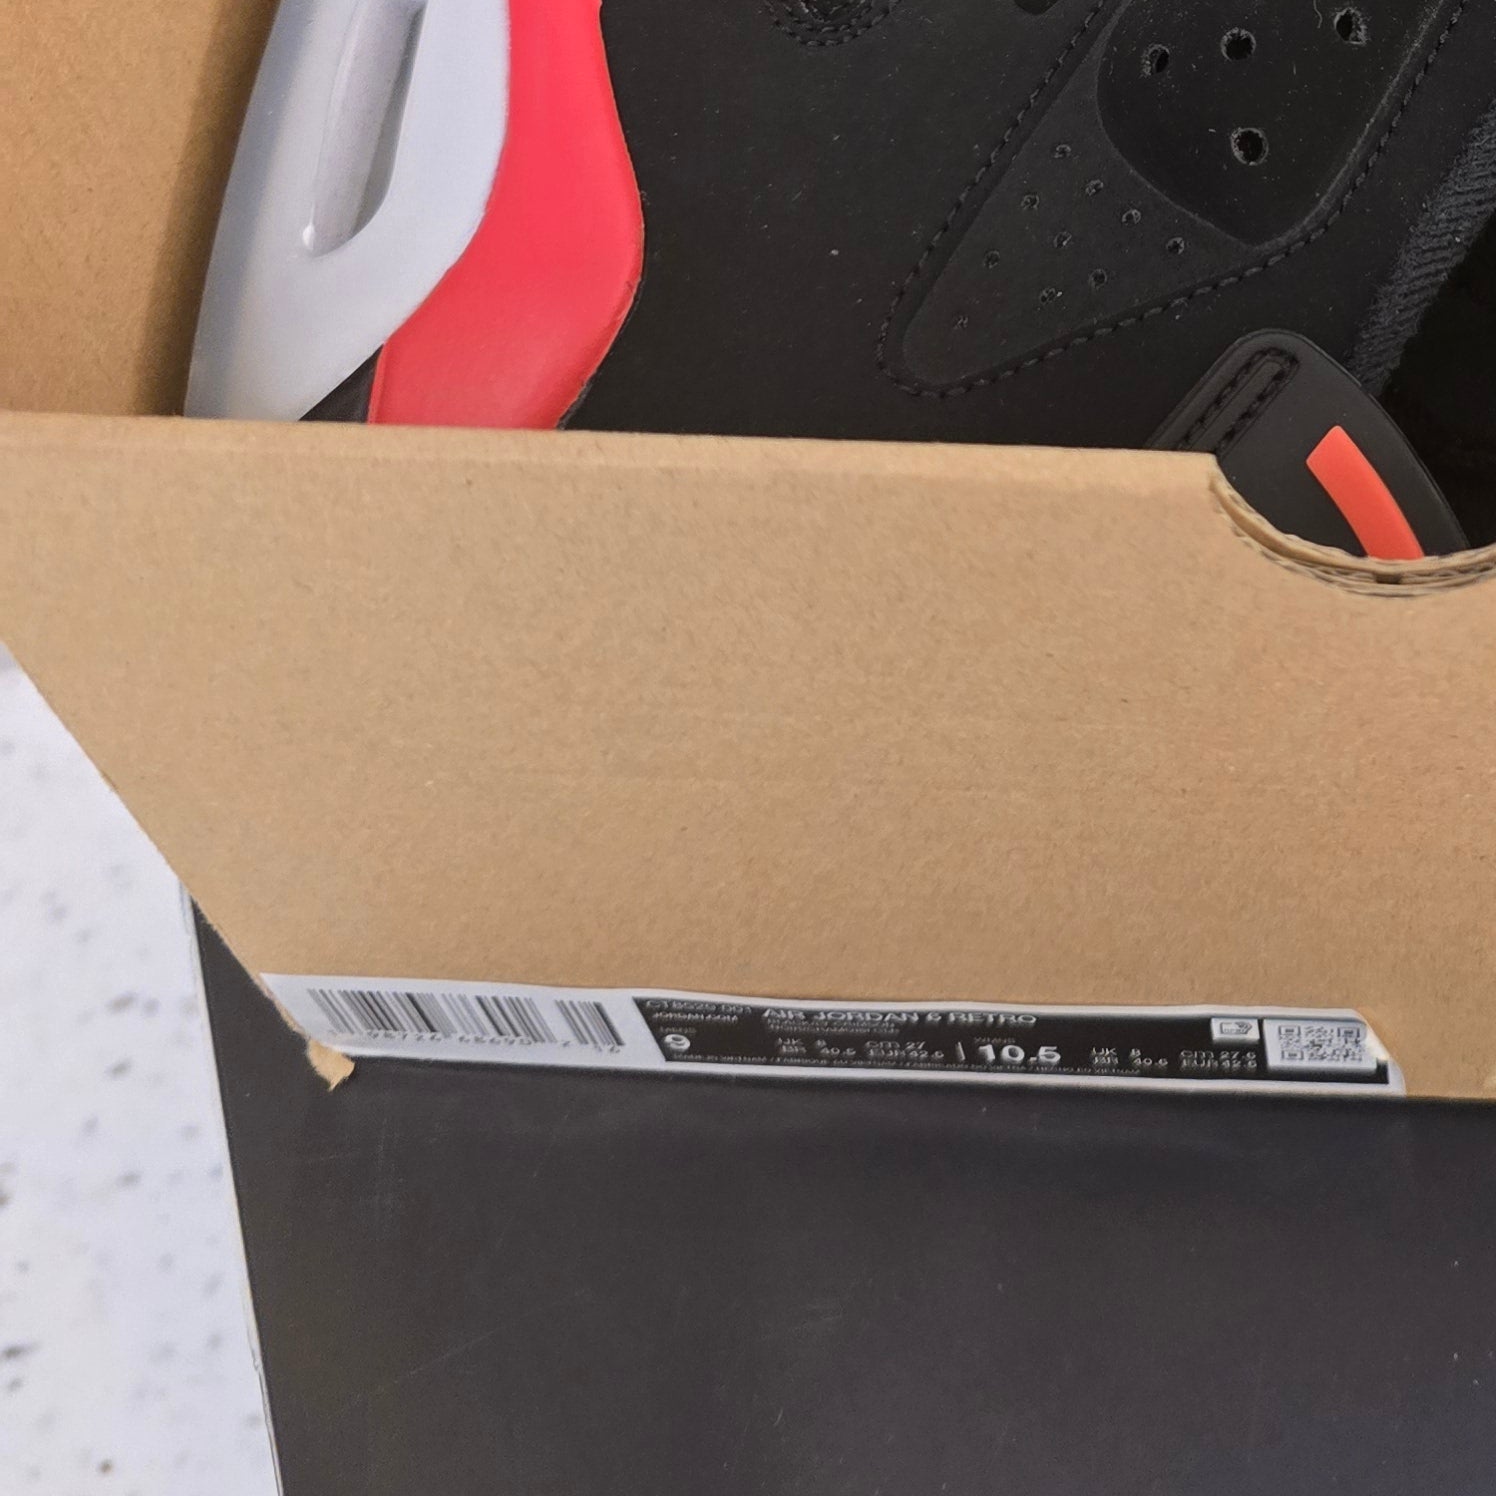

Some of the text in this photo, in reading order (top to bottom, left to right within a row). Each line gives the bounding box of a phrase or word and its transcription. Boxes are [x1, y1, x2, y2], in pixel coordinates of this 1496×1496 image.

[763, 1008, 806, 1021] AIR
[814, 1011, 920, 1024] JORDAN
[948, 1013, 1038, 1026] RETRO
[663, 1033, 691, 1051] 9
[977, 1043, 1062, 1066] 10.5
